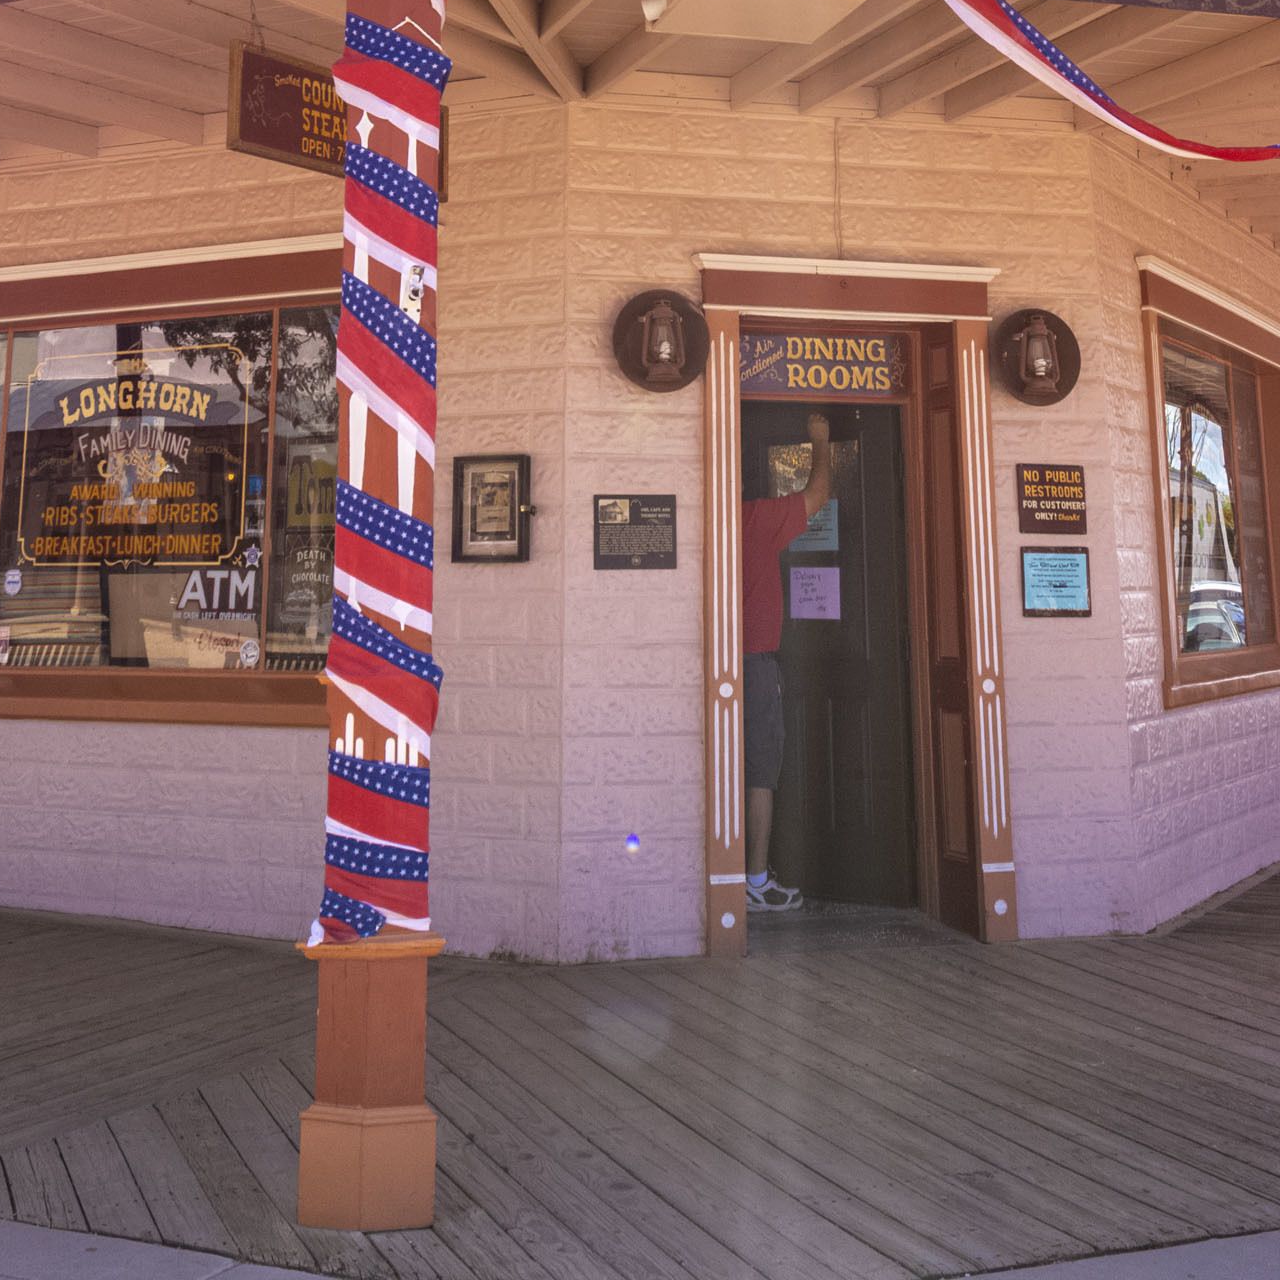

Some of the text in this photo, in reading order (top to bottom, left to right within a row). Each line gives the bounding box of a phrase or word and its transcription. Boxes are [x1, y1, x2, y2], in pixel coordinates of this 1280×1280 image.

[753, 337, 776, 359] Air
[786, 336, 886, 362] DINING
[786, 364, 891, 390] ROOMS
[59, 380, 212, 427] LONGHORN
[78, 429, 135, 462] FAMILY
[139, 422, 192, 464] DINING
[1023, 470, 1081, 483] NO PUBLIC
[70, 481, 195, 500] AWARD WINNING
[1024, 484, 1083, 498] RESTROOMS
[45, 506, 78, 526] RIBS
[149, 502, 219, 524] BURGERS
[1023, 500, 1086, 510] FOR CUSTOMERS
[35, 534, 221, 556] BREAKFAST LUNCH DINNER
[296, 550, 326, 562] DEATH
[177, 569, 256, 610] ATM
[291, 573, 329, 584] CHOCOLATE
